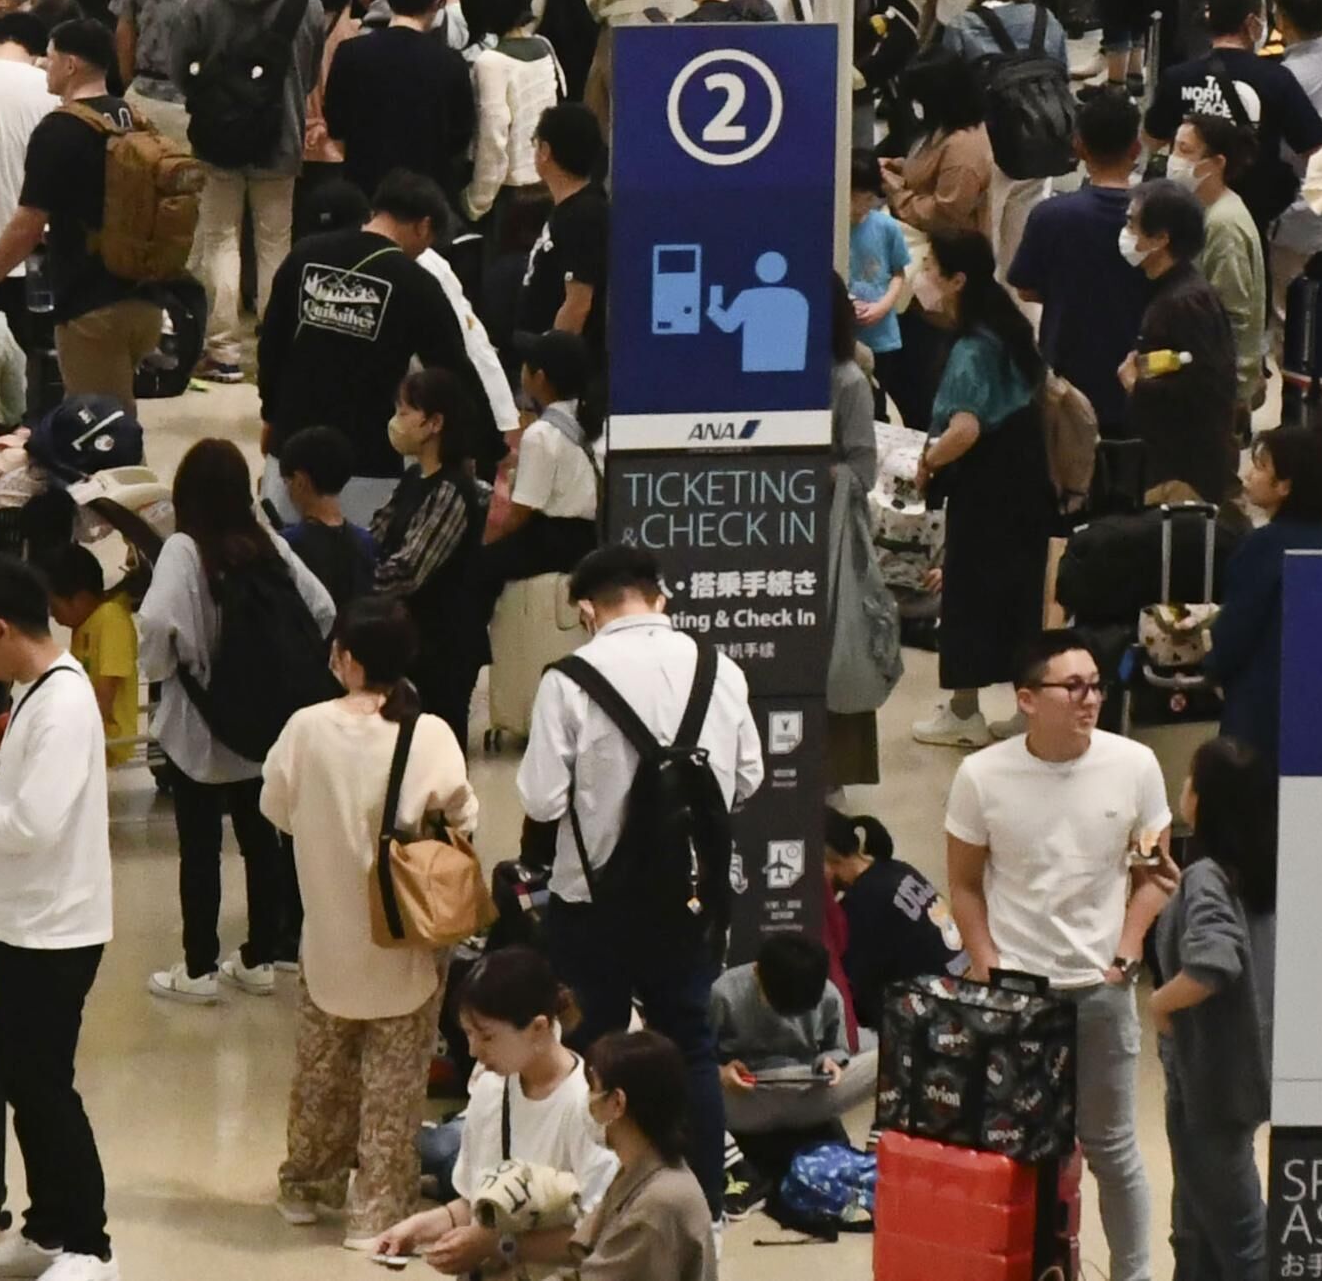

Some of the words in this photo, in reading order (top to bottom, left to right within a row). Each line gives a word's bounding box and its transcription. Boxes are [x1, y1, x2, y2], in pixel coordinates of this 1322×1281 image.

[701, 72, 748, 142] 2
[1181, 86, 1223, 103] NORT
[1194, 100, 1232, 118] FACE
[303, 299, 376, 329] Quiksilver
[688, 422, 735, 440] ANA
[623, 469, 816, 507] TICKETING
[779, 511, 816, 545] IN
[715, 610, 730, 628] &
[734, 609, 793, 629] Check
[797, 609, 816, 626] In
